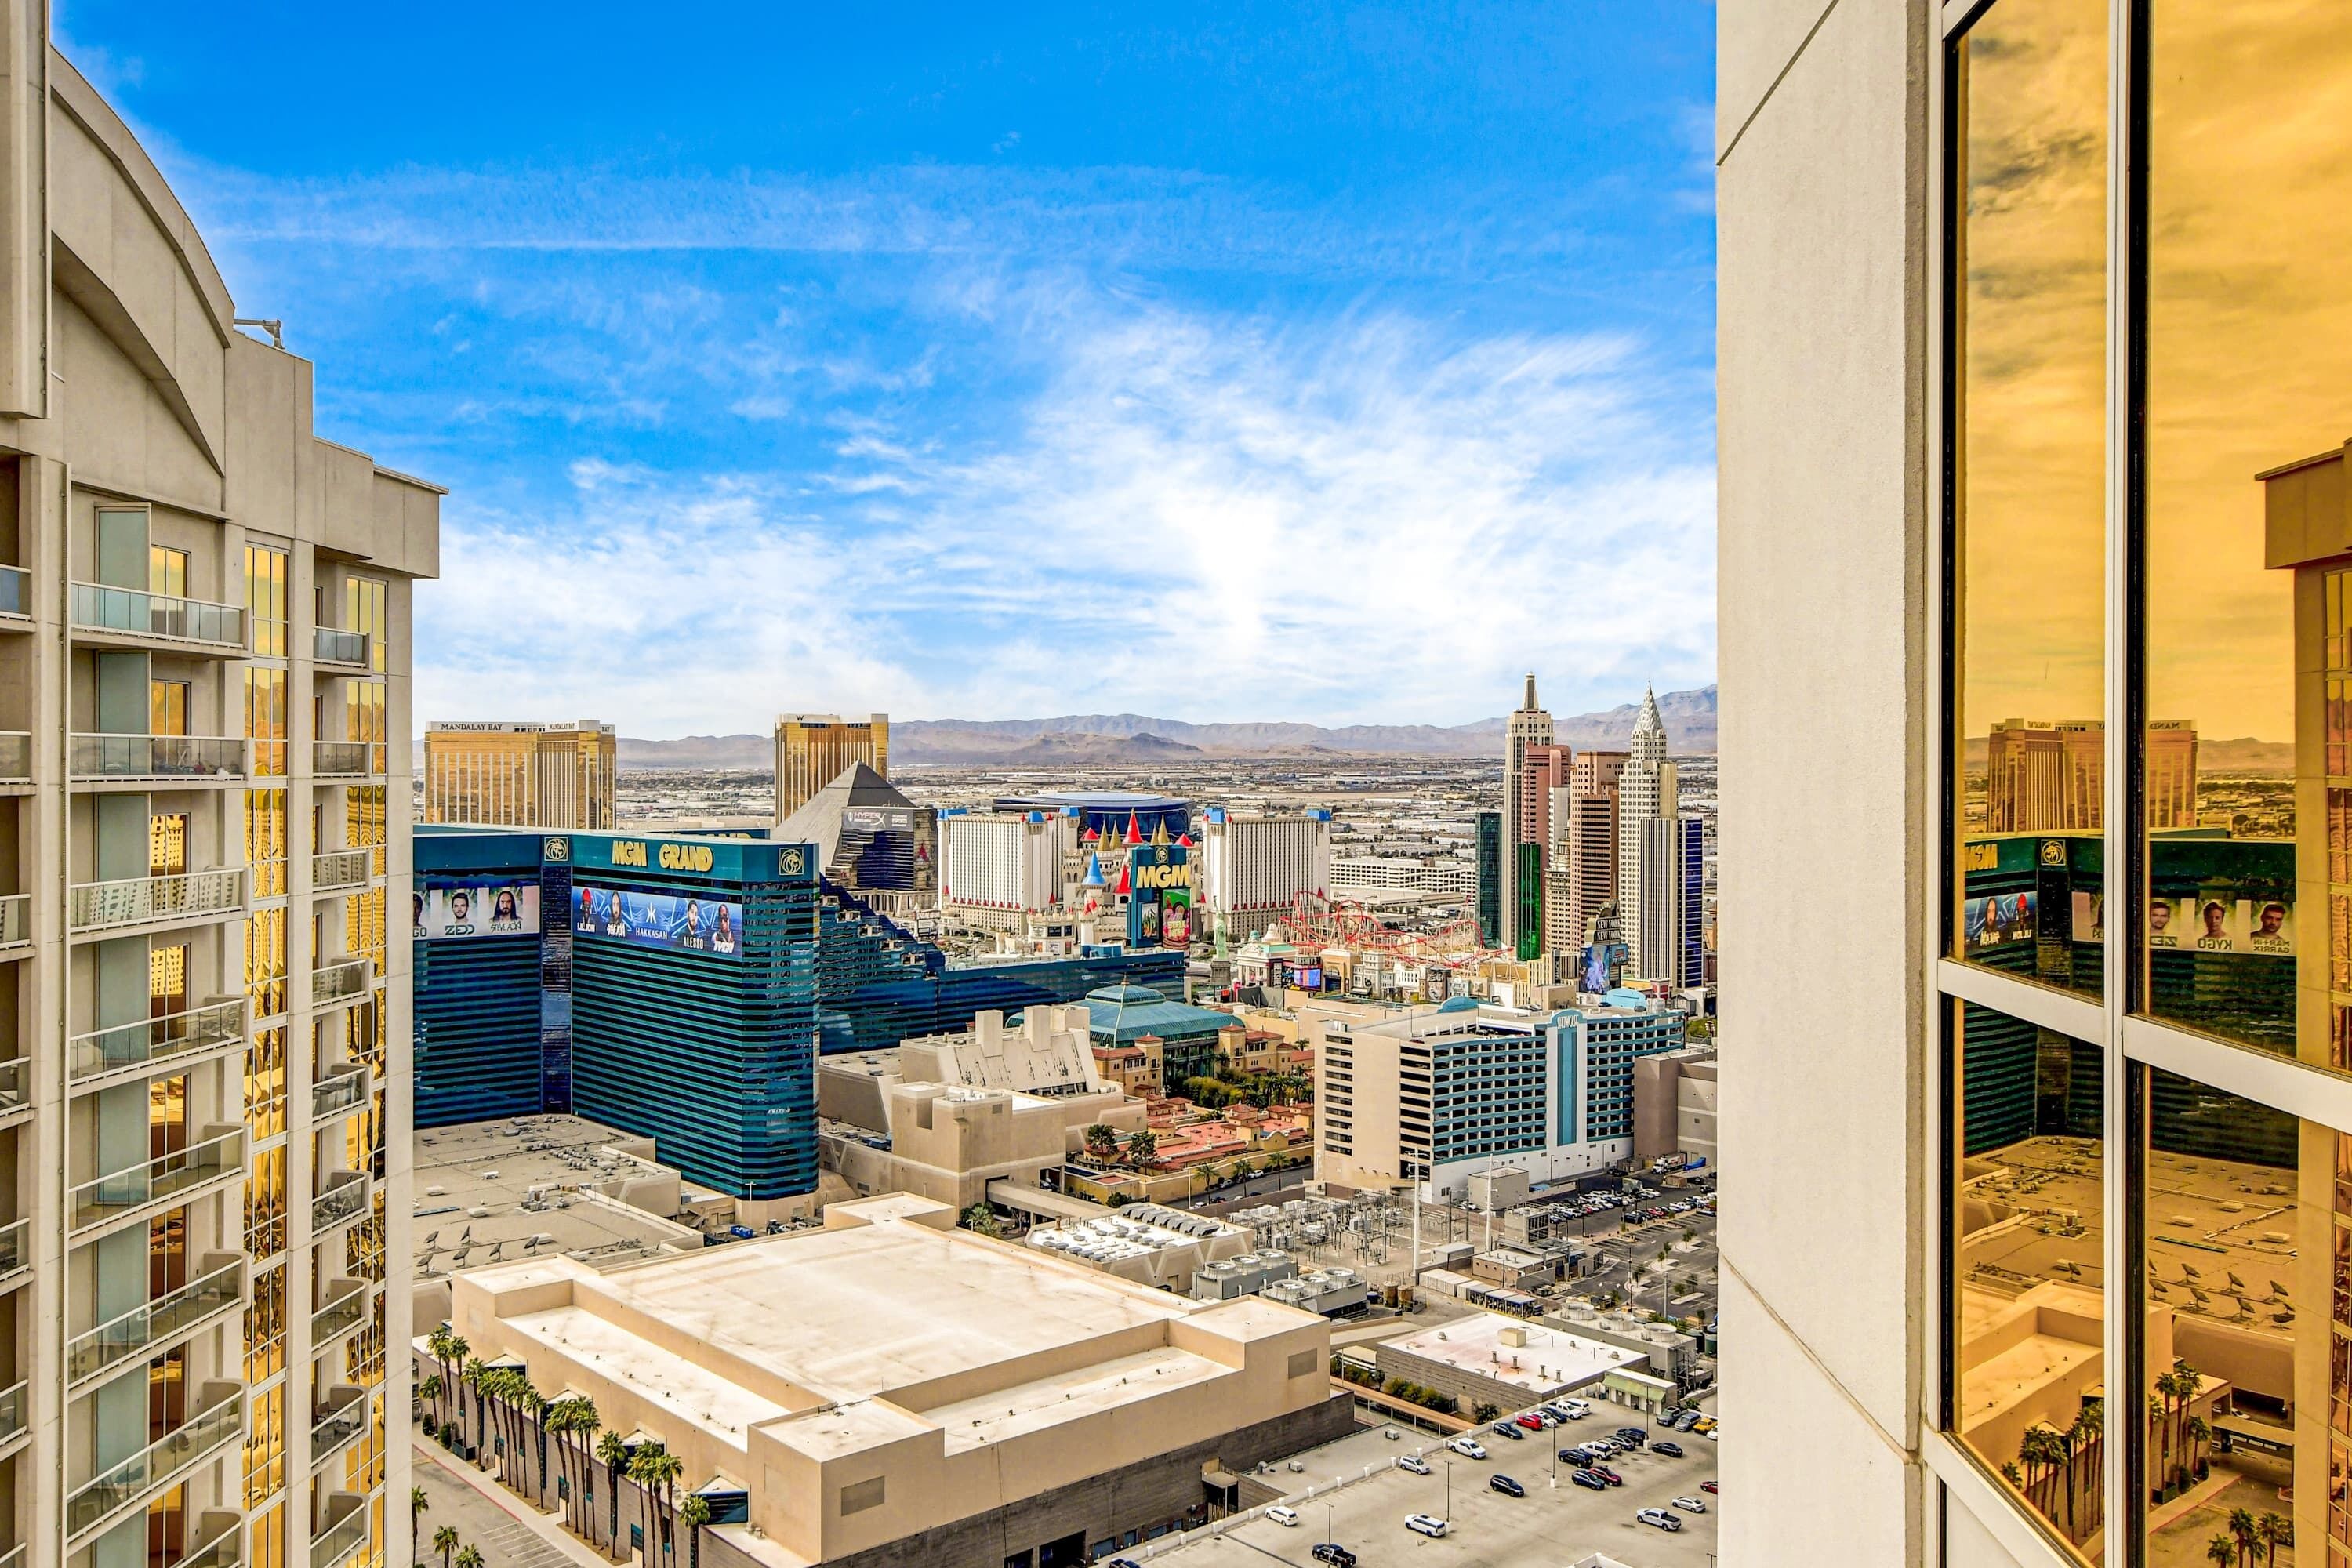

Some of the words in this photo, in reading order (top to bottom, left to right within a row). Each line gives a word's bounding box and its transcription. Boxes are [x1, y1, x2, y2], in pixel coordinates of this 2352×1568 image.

[612, 840, 648, 867] MGM
[659, 843, 713, 873] GRAND
[1136, 864, 1192, 888] MGM
[1597, 920, 1609, 929] NEW
[635, 927, 669, 940] HAKKASAN
[1597, 931, 1609, 941] NEW
[683, 935, 704, 949] ALESSO
